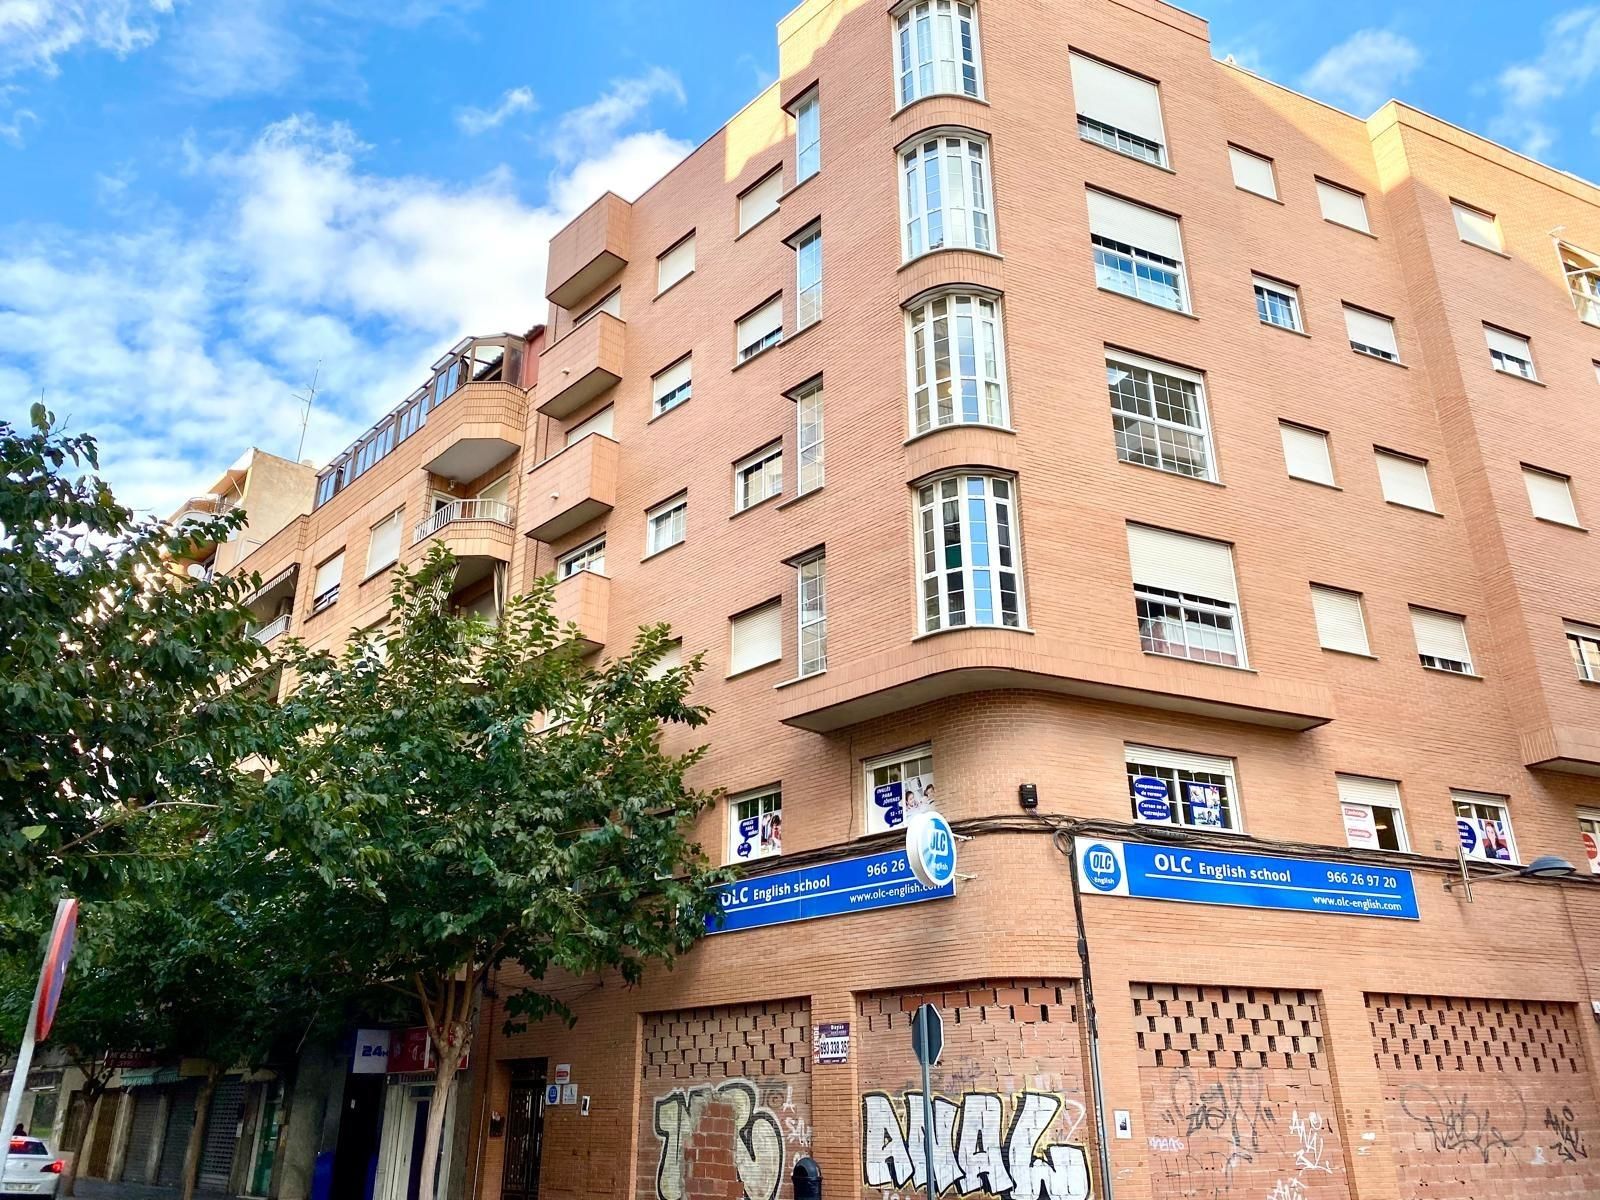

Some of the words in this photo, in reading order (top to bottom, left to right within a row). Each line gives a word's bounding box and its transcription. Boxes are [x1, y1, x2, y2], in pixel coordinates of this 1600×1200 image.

[866, 862, 888, 878] 966
[891, 859, 905, 873] 26
[1093, 853, 1112, 870] OLC
[1154, 853, 1193, 874] OLC
[1199, 862, 1247, 880] English
[1250, 867, 1291, 882] school
[753, 882, 791, 902] English
[793, 875, 830, 893] school
[1326, 871, 1349, 884] 966
[1350, 873, 1365, 885] 26
[1366, 874, 1379, 887] 97
[1382, 876, 1397, 889] 20
[1312, 896, 1402, 911] www.olc-english.com
